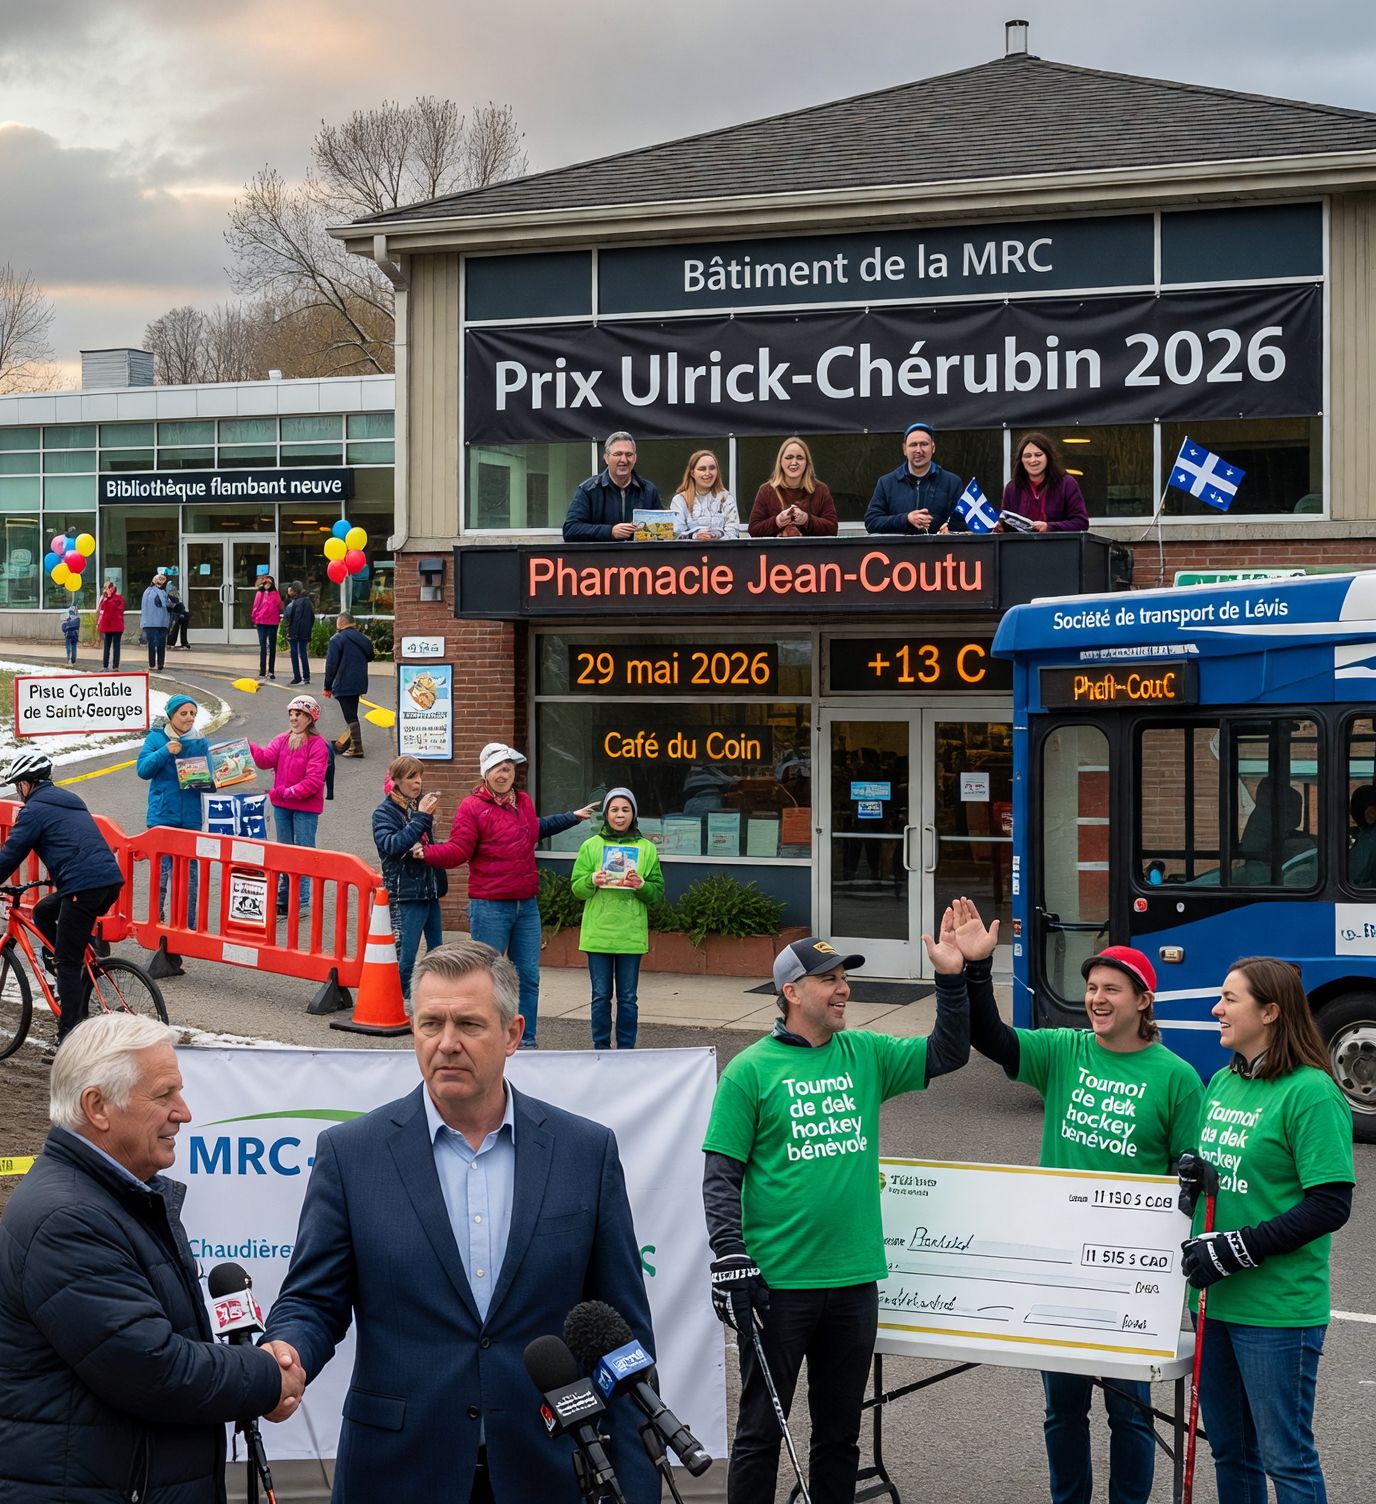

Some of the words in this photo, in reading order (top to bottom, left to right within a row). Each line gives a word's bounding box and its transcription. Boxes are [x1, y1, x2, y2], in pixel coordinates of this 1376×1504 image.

[684, 253, 848, 292] Bâtiment
[859, 246, 905, 281] de
[918, 244, 948, 279] la
[962, 237, 1053, 276] MRC
[495, 356, 603, 411] Prix
[621, 332, 1101, 406] Ulrick-Chérubin
[1124, 325, 1287, 388] 2026
[211, 477, 286, 497] flambant
[291, 479, 342, 494] neuve
[529, 556, 733, 597] Pharmacie
[747, 551, 982, 595] Jean-Coutu
[1115, 607, 1135, 626] de
[1139, 602, 1214, 627] transport
[1219, 601, 1239, 619] de
[1245, 598, 1289, 618] Lévis
[576, 652, 614, 685] 29
[626, 652, 679, 684] mai
[690, 651, 770, 684] 2026
[867, 645, 941, 683] +13
[956, 643, 986, 682] C
[24, 706, 41, 719] de
[604, 731, 659, 760] Café
[668, 732, 697, 759] du
[706, 731, 761, 760] Coin
[789, 1098, 816, 1117] de
[821, 1093, 856, 1114] dek
[1071, 1088, 1095, 1107] de
[791, 1116, 862, 1139] hockey
[1066, 1103, 1136, 1138] hockey
[189, 1238, 295, 1259] Chaudière
[1103, 1250, 1125, 1264] 515
